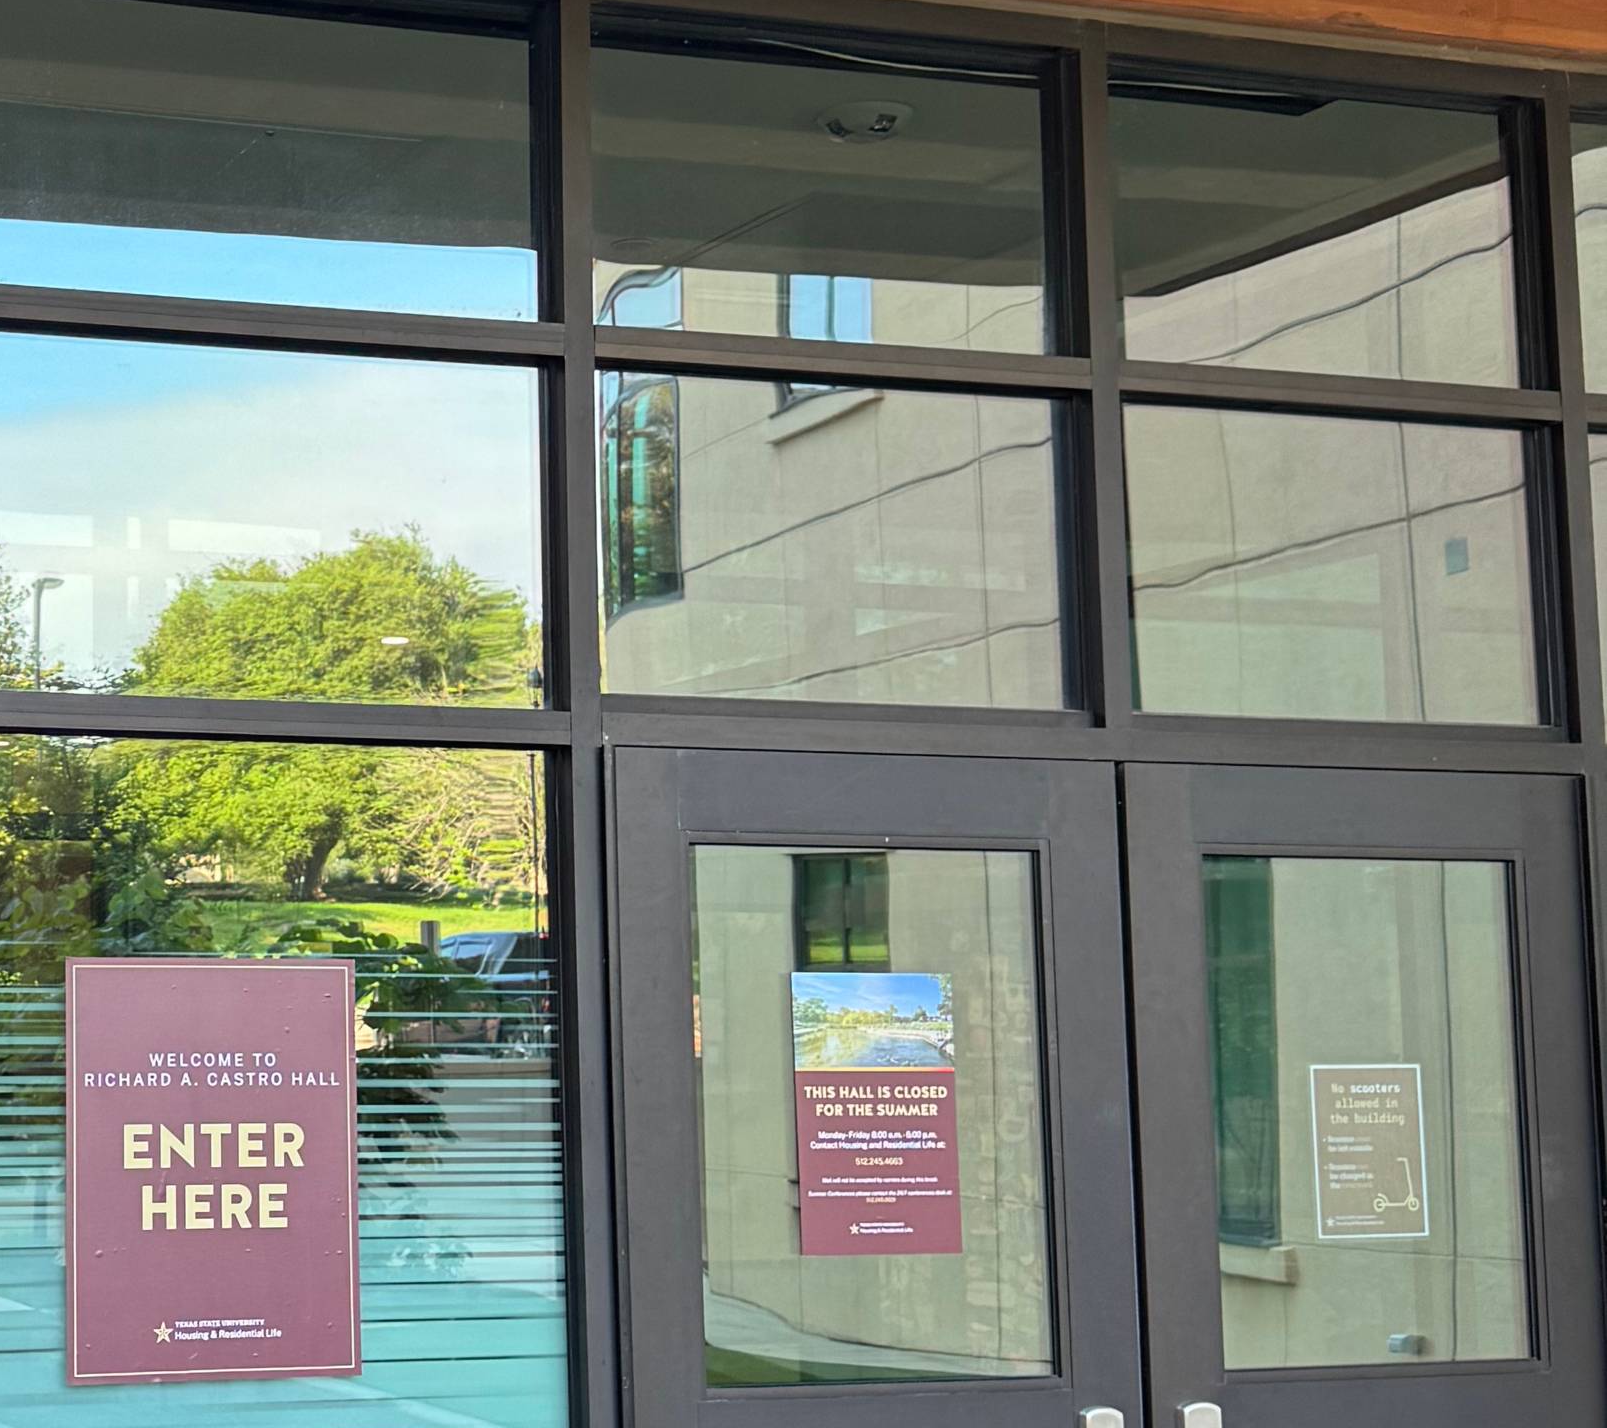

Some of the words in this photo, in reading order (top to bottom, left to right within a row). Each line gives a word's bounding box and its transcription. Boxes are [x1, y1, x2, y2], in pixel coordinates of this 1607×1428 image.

[149, 1053, 244, 1067] WELCOME
[252, 1053, 277, 1067] TO
[84, 1072, 172, 1087] RICHARD
[180, 1073, 198, 1087] A.
[207, 1072, 283, 1087] CASTRO
[291, 1072, 340, 1087] HALL
[804, 1086, 836, 1099] THIS
[839, 1086, 874, 1099] HALL
[878, 1086, 891, 1099] IS
[894, 1086, 948, 1098] CLOSED
[1330, 1083, 1345, 1093] No
[1350, 1083, 1401, 1093] scooters
[1335, 1097, 1379, 1109] allowed
[1385, 1097, 1399, 1108] in
[815, 1104, 843, 1116] FOR
[847, 1104, 874, 1116] THE
[876, 1104, 938, 1116] SUMMER
[1330, 1113, 1349, 1124] the
[1354, 1112, 1405, 1126] building
[123, 1123, 305, 1169] ENTER
[810, 1141, 838, 1149] Contact
[839, 1141, 868, 1150] Housing
[868, 1141, 882, 1149] and
[883, 1140, 921, 1149] Residential
[922, 1140, 936, 1149] Life
[142, 1183, 288, 1230] HERE
[174, 1320, 198, 1328] TEXAS
[198, 1320, 221, 1328] STATE
[221, 1319, 265, 1327] UNIVERSITY
[175, 1330, 209, 1340] Housing
[210, 1330, 217, 1339] &
[218, 1329, 265, 1339] Residential
[266, 1328, 282, 1338] Life
